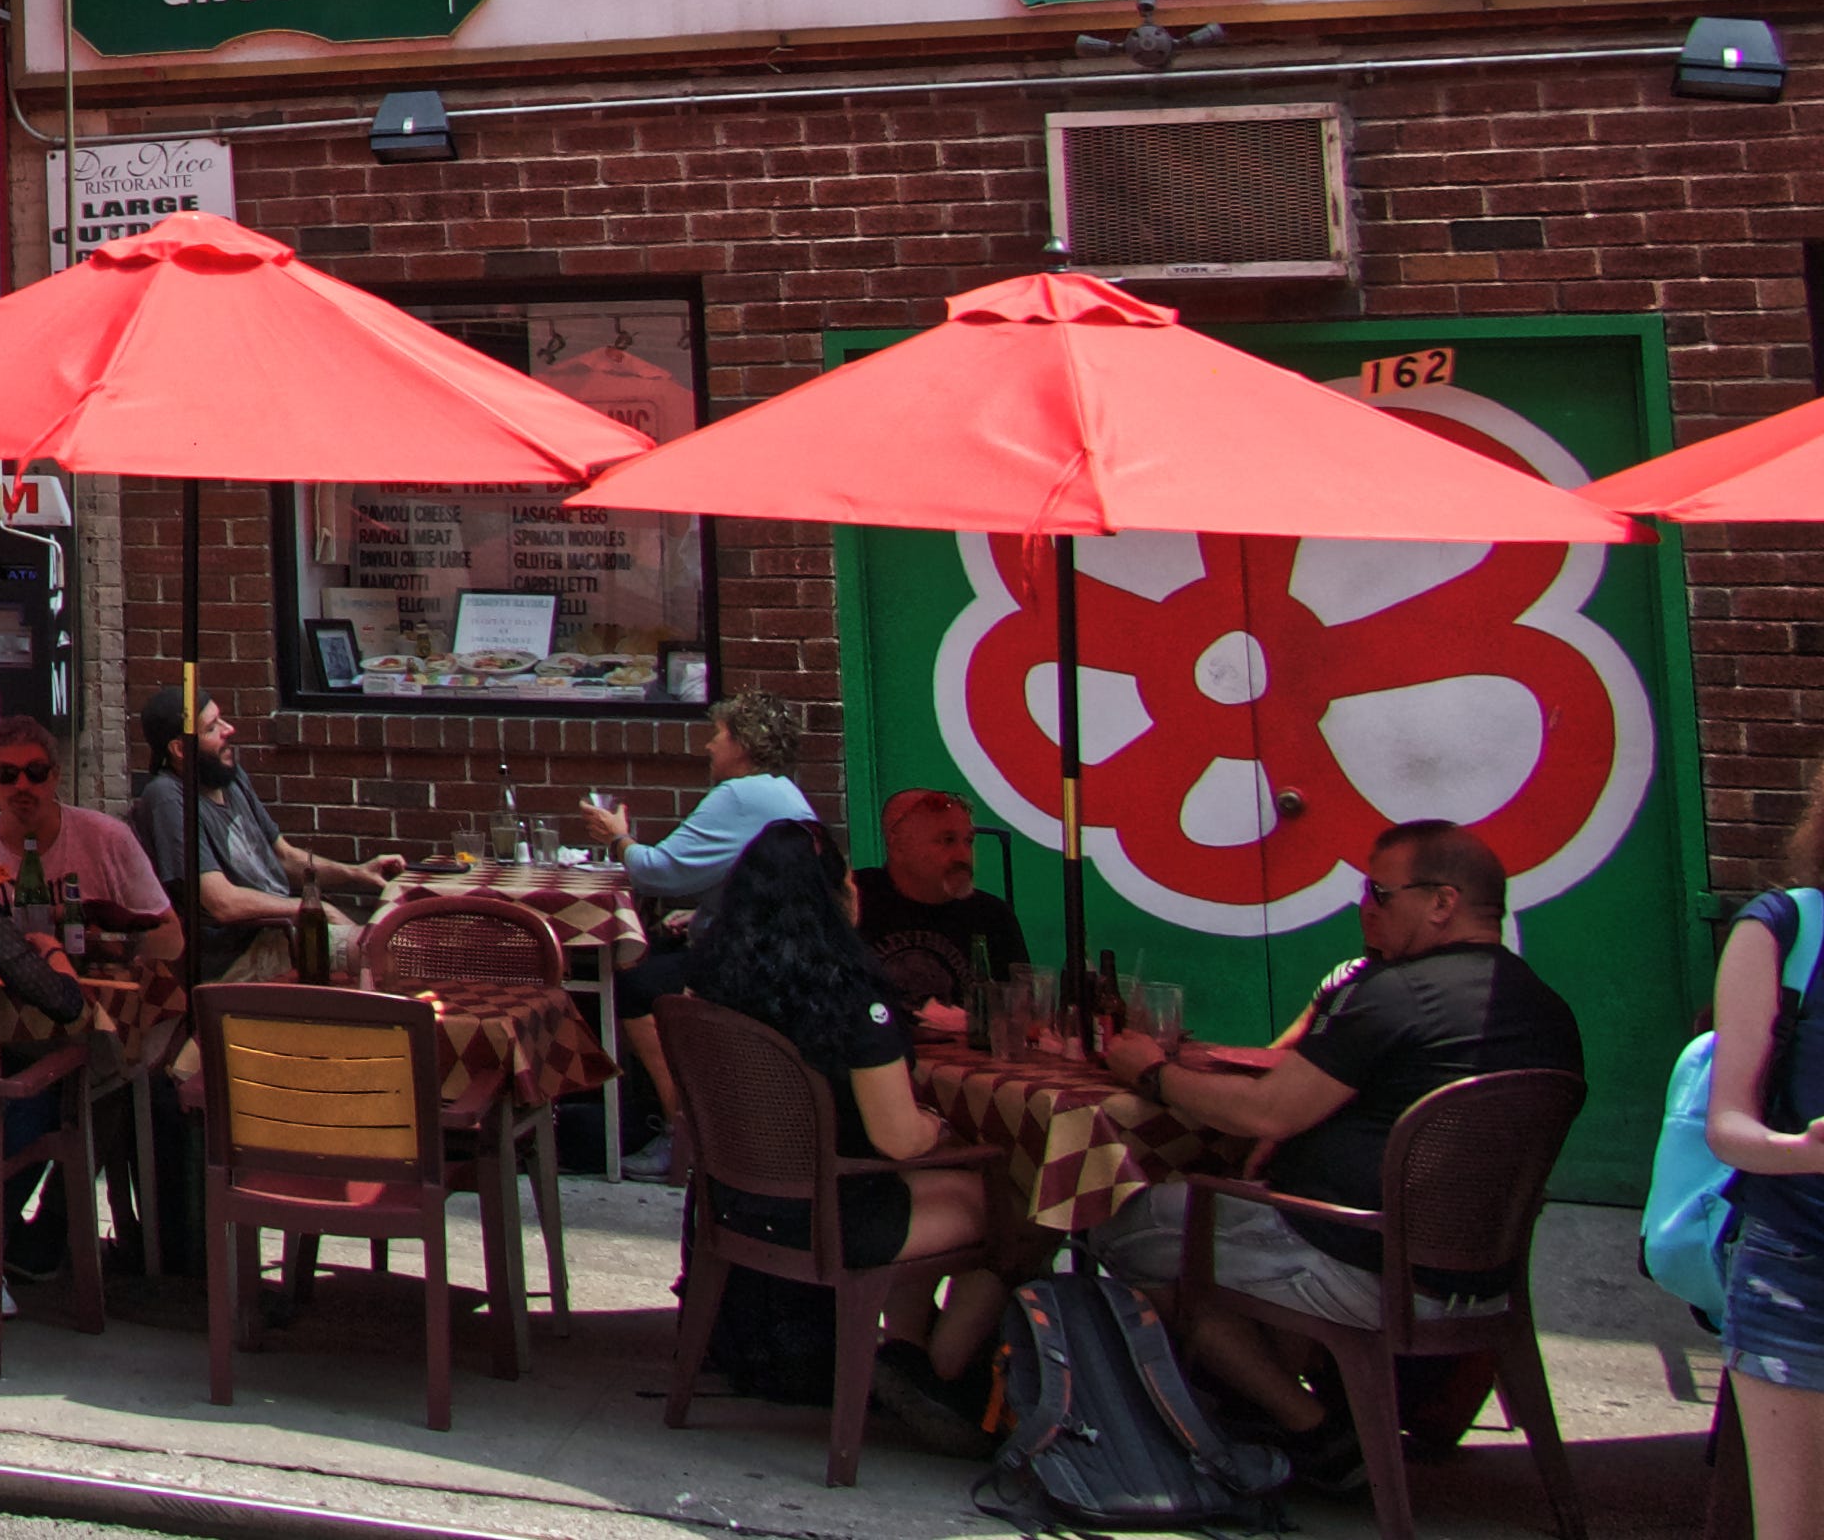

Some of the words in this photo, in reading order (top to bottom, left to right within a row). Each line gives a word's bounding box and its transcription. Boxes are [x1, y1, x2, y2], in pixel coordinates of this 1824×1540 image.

[72, 149, 120, 181] Da
[127, 141, 216, 177] Nico
[85, 174, 192, 195] RISTORANTE
[82, 195, 200, 219] LARGE
[52, 221, 166, 244] OUTD
[1369, 350, 1448, 395] 162
[359, 505, 409, 523] RAVIOLI
[413, 504, 462, 523] CHEESE
[512, 506, 573, 525] LASAGNE
[579, 507, 608, 525] EGG
[359, 529, 409, 545] RAVIOLI
[414, 529, 453, 546] MEAT
[514, 529, 564, 547] SPINACH
[568, 530, 627, 547] NOODLES
[514, 552, 563, 570] GLUTEN
[360, 573, 429, 591] MANICOTTI
[398, 596, 441, 614] ELLONI
